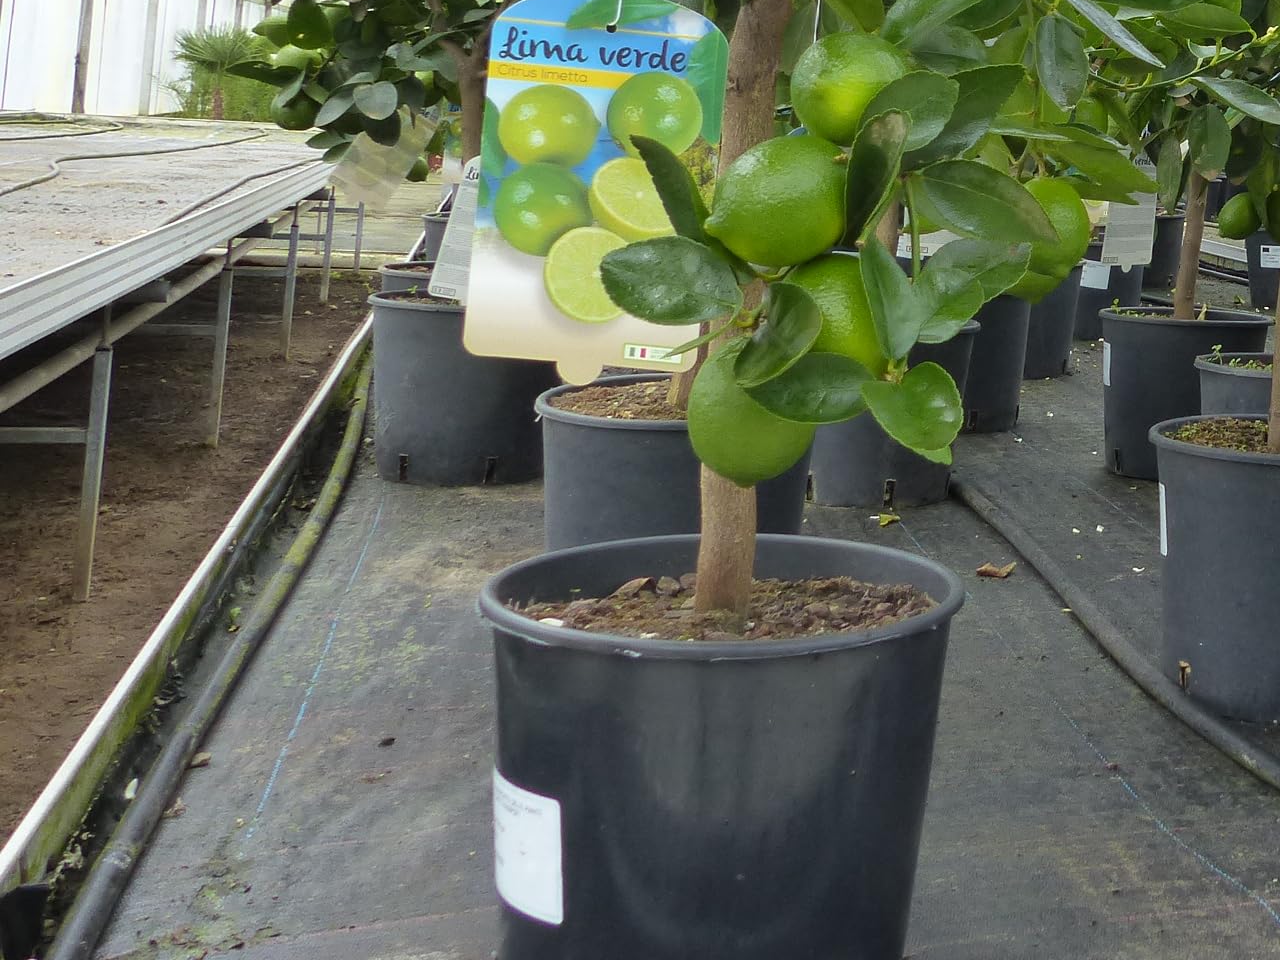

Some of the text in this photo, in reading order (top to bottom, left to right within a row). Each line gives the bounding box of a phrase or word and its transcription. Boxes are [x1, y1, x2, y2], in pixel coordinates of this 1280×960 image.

[498, 26, 687, 73] Lima verde
[497, 64, 588, 83] Citrus limetta
